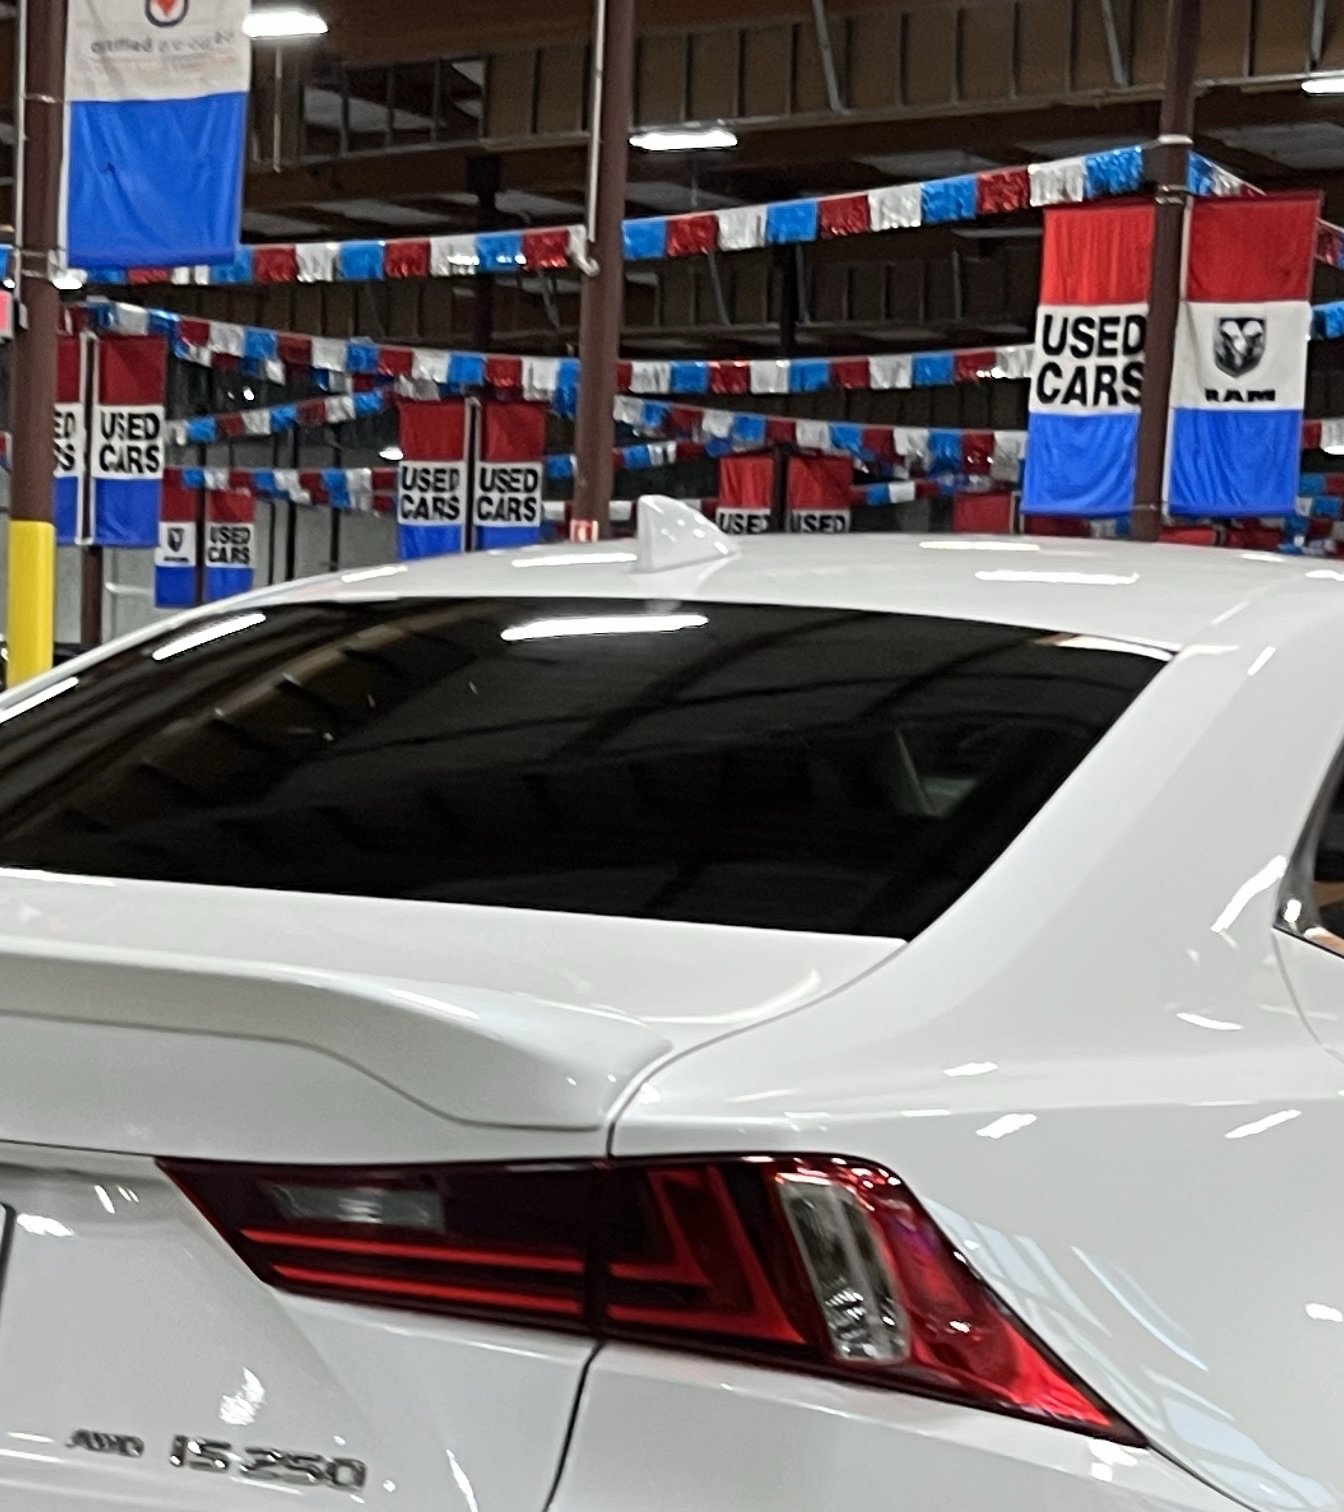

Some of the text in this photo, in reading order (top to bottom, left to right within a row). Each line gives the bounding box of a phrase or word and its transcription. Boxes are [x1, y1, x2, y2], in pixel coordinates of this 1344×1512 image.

[1042, 315, 1146, 358] USED
[1036, 362, 1144, 406] CARS
[1205, 389, 1275, 403] RAM
[101, 410, 160, 440] USED
[100, 445, 160, 473] CARS
[402, 466, 460, 493] USED
[480, 467, 538, 493] USED
[400, 494, 460, 521] CARS
[477, 496, 537, 522] CARS
[210, 526, 251, 545] USED
[720, 512, 771, 533] USED
[791, 513, 846, 534] USED
[208, 547, 251, 564] CARS
[169, 1434, 233, 1474] IS
[239, 1445, 368, 1493] 250
